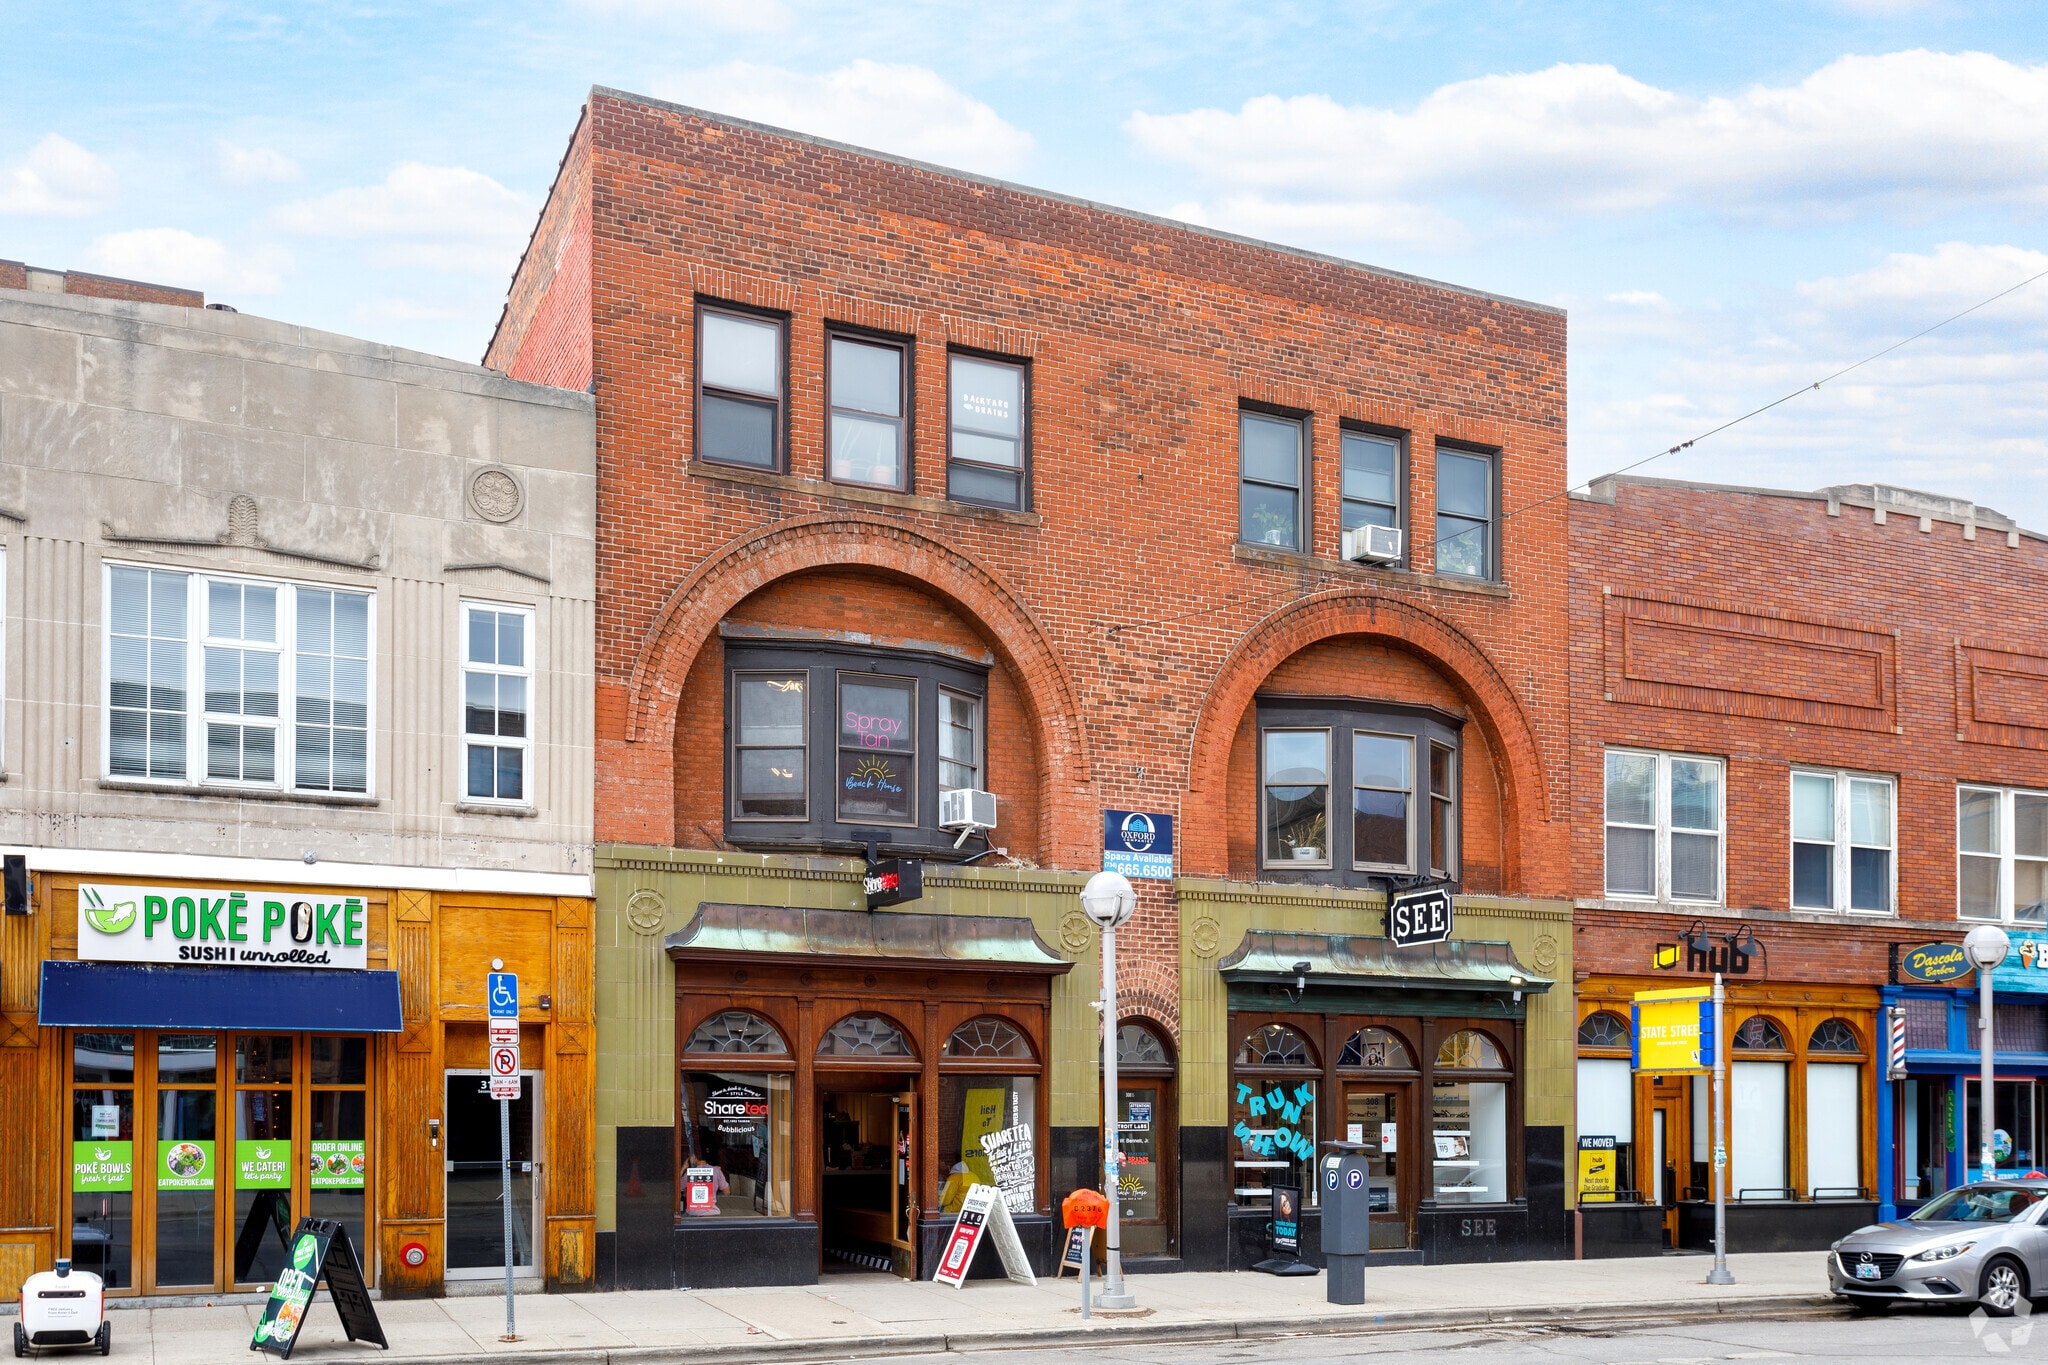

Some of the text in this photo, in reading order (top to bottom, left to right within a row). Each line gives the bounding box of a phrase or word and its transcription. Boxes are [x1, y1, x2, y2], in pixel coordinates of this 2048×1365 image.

[963, 393, 1009, 409] BACKYARD
[975, 405, 1008, 418] BRAINS
[845, 711, 902, 735] Spray
[858, 729, 890, 748] Tan
[845, 775, 875, 791] Beach
[877, 777, 902, 793] House
[1121, 830, 1156, 841] OXFORD
[1104, 851, 1172, 864] Space Available
[1104, 861, 1172, 877] (734) 665.6500
[1396, 900, 1445, 938] SEE
[179, 945, 332, 965] SUSHI unrolled
[1687, 934, 1750, 974] hub
[1912, 948, 1964, 969] Dascola
[1924, 964, 1957, 977] Barbers
[1640, 1023, 1700, 1039] STATE STREE
[704, 1100, 769, 1115] Sharetea
[1235, 1081, 1314, 1125] TRUNK
[1366, 1097, 1379, 1105] 308
[717, 1124, 755, 1133] Bubblicious
[312, 1142, 363, 1152] ORDER ONLINE
[1012, 1141, 1031, 1153] Life
[1233, 1121, 1315, 1162] SHOW
[1581, 1137, 1614, 1148] WE MOVED
[241, 1161, 286, 1172] WE CATER!
[1127, 1156, 1149, 1165] BRAINS
[100, 1162, 131, 1174] BOWLS
[81, 1174, 101, 1185] fresh
[107, 1174, 125, 1184] fast
[158, 1178, 214, 1187] EATPOKEPOKE.COM
[259, 1172, 283, 1182] party
[311, 1177, 364, 1185] EATPOKEPOKE.COM
[1275, 1226, 1296, 1237] TODAY
[1461, 1218, 1496, 1237] SEE
